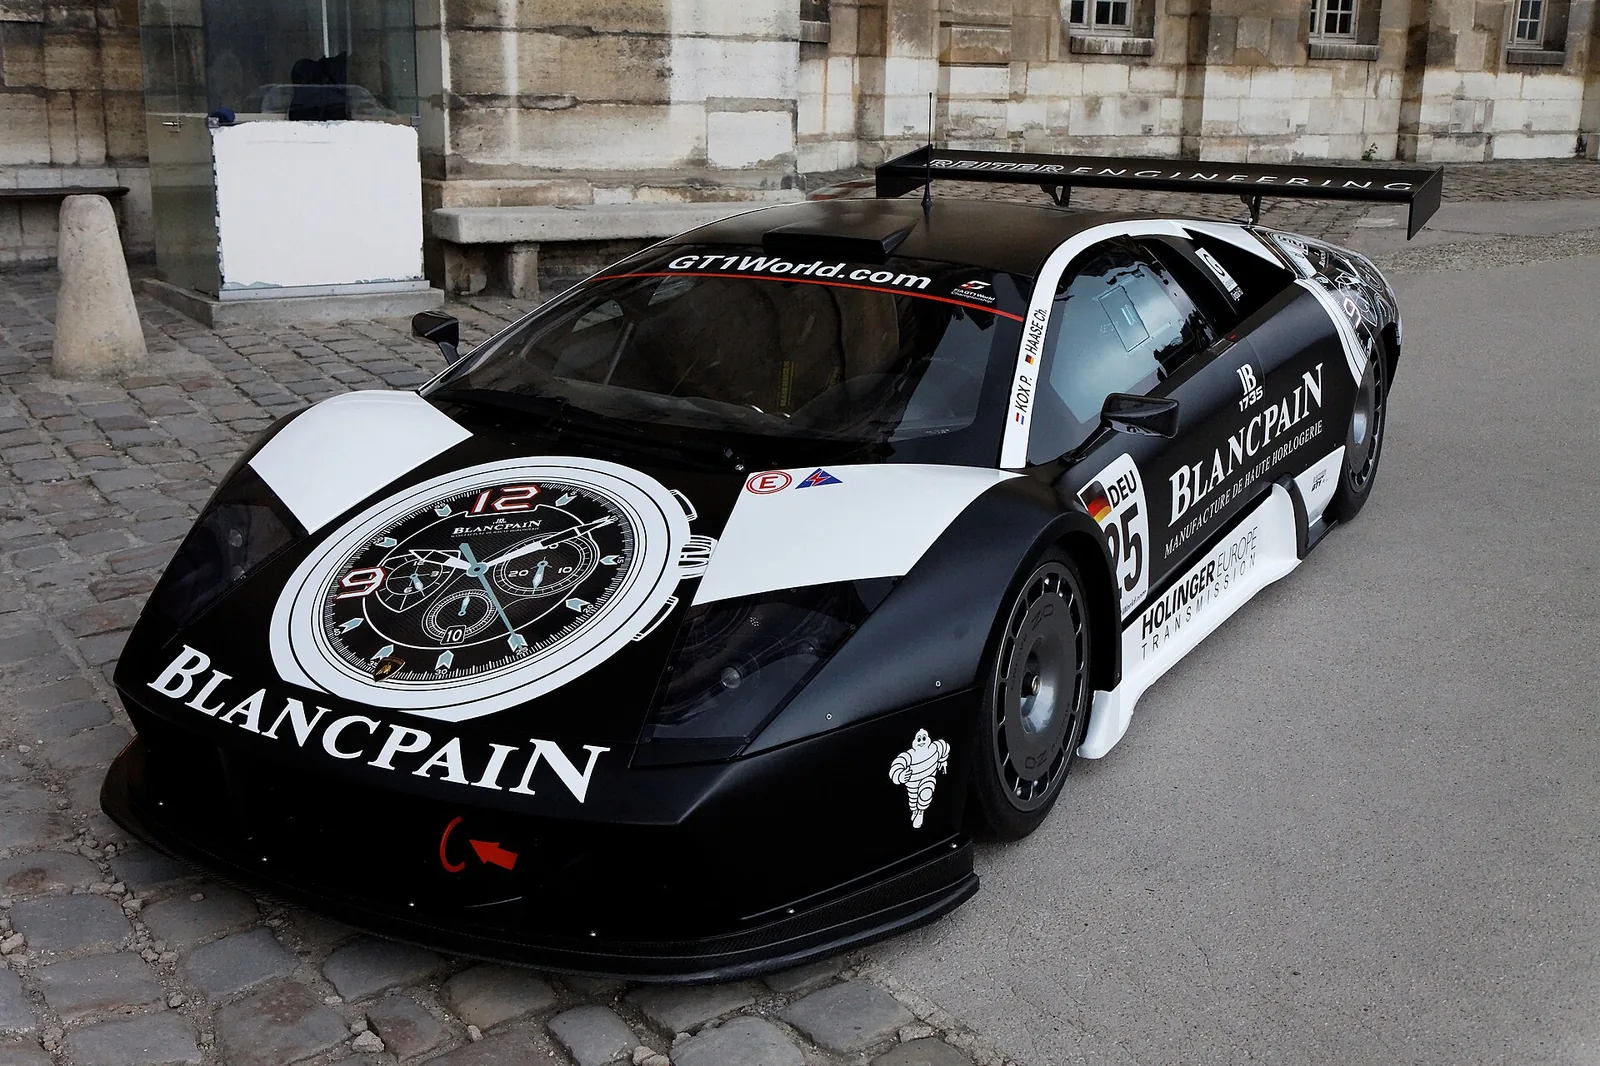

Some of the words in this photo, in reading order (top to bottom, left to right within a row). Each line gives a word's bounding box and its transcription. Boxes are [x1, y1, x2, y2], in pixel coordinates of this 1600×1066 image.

[923, 159, 1064, 173] REITER
[1070, 166, 1411, 190] ENGINEERING
[668, 255, 932, 289] GT1World.com
[1024, 321, 1044, 356] HAASE
[1034, 308, 1048, 324] Ch.
[1020, 375, 1033, 387] P.
[1015, 387, 1031, 413] KOX
[1239, 385, 1263, 412] 1735
[1167, 362, 1323, 528] BLANCPAIN
[472, 485, 541, 514] 12
[1107, 469, 1137, 508] DEU
[1163, 493, 1231, 560] MANUFACTURE
[1232, 479, 1243, 499] DE
[1244, 456, 1271, 488] HAUTE
[1271, 419, 1323, 467] HORLOGERIE
[452, 520, 542, 535] BLANCPAIN
[333, 566, 387, 600] 9
[508, 569, 529, 577] 20
[558, 566, 572, 574] 10
[1142, 560, 1215, 640] HOLINGER
[1217, 526, 1258, 577] EUROPE
[1141, 552, 1256, 660] TRANSMISSION
[445, 629, 463, 642] 10
[147, 644, 611, 803] BLANCPAIN
